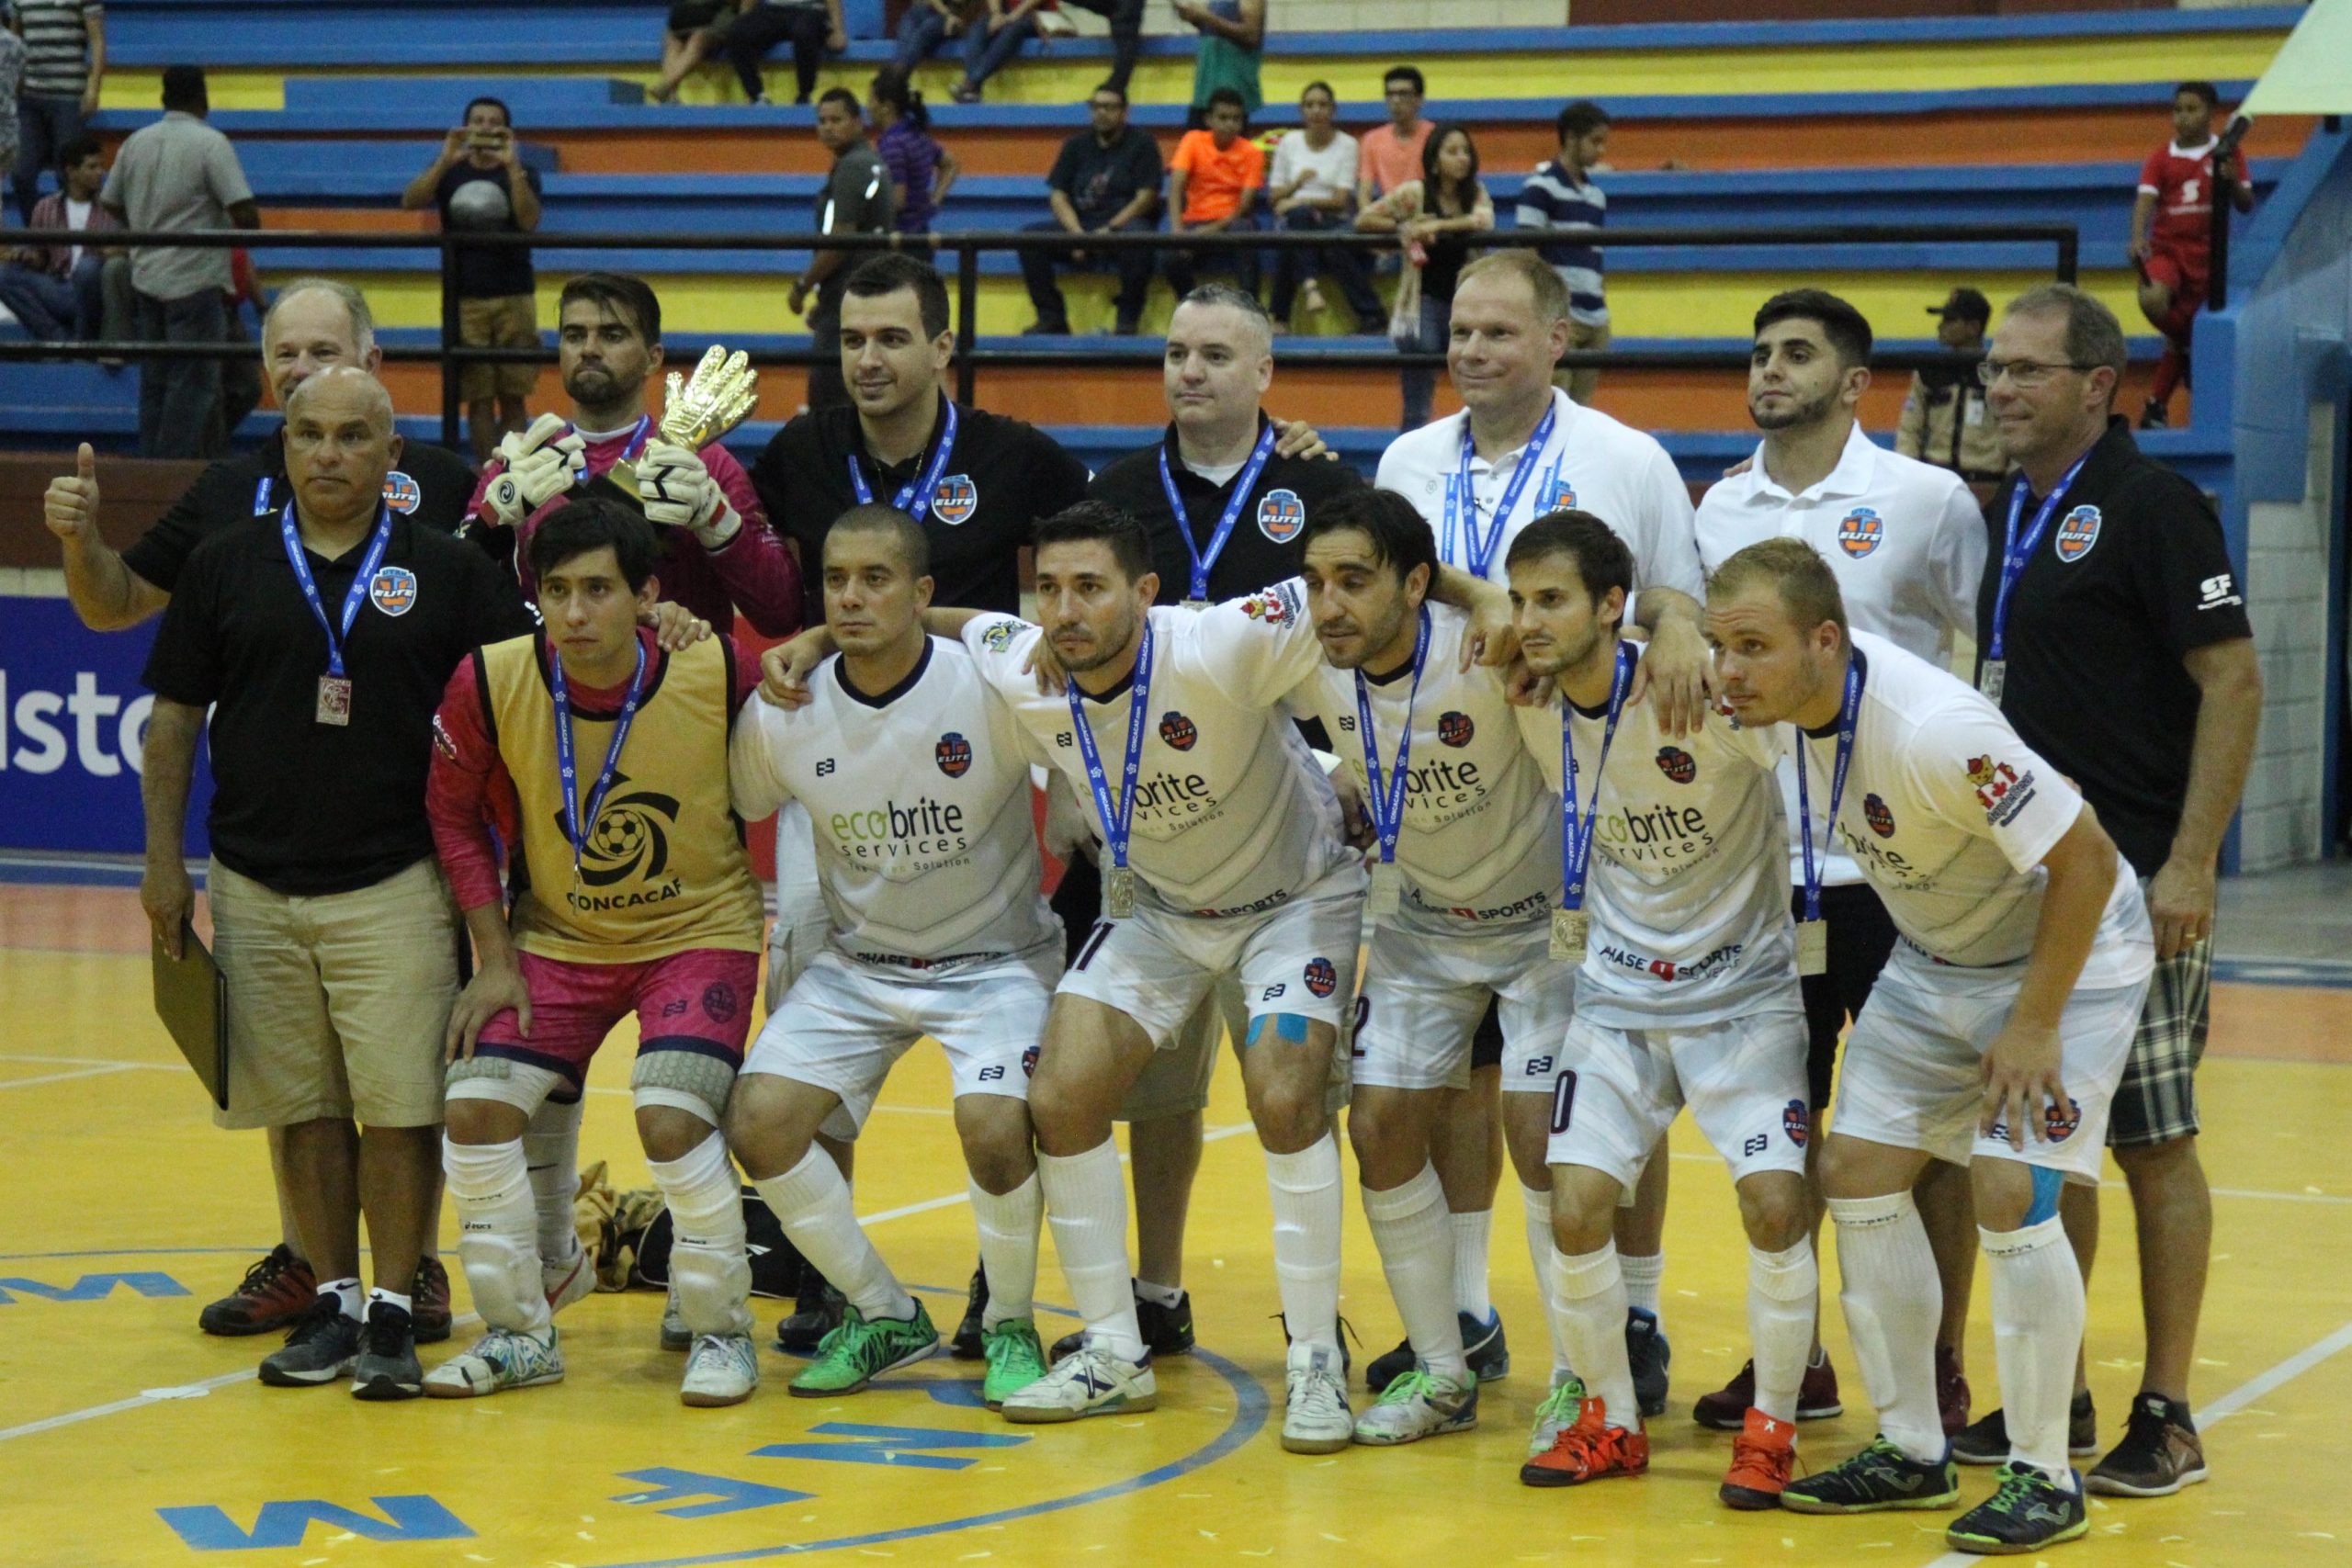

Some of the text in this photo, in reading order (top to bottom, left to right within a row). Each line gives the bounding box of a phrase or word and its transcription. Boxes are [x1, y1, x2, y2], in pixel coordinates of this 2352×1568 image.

[934, 498, 974, 506] ELITE
[1261, 513, 1302, 524] ELITE
[1838, 531, 1881, 541] ELITE
[2059, 532, 2095, 541] ELITE
[374, 590, 414, 598] ELITE
[1163, 727, 1194, 741] ELITE
[937, 753, 971, 763] ELITE
[831, 795, 964, 841] ecobrite
[842, 836, 967, 858] services
[1478, 891, 1546, 919] SPORTS
[1306, 975, 1335, 987] ELITE
